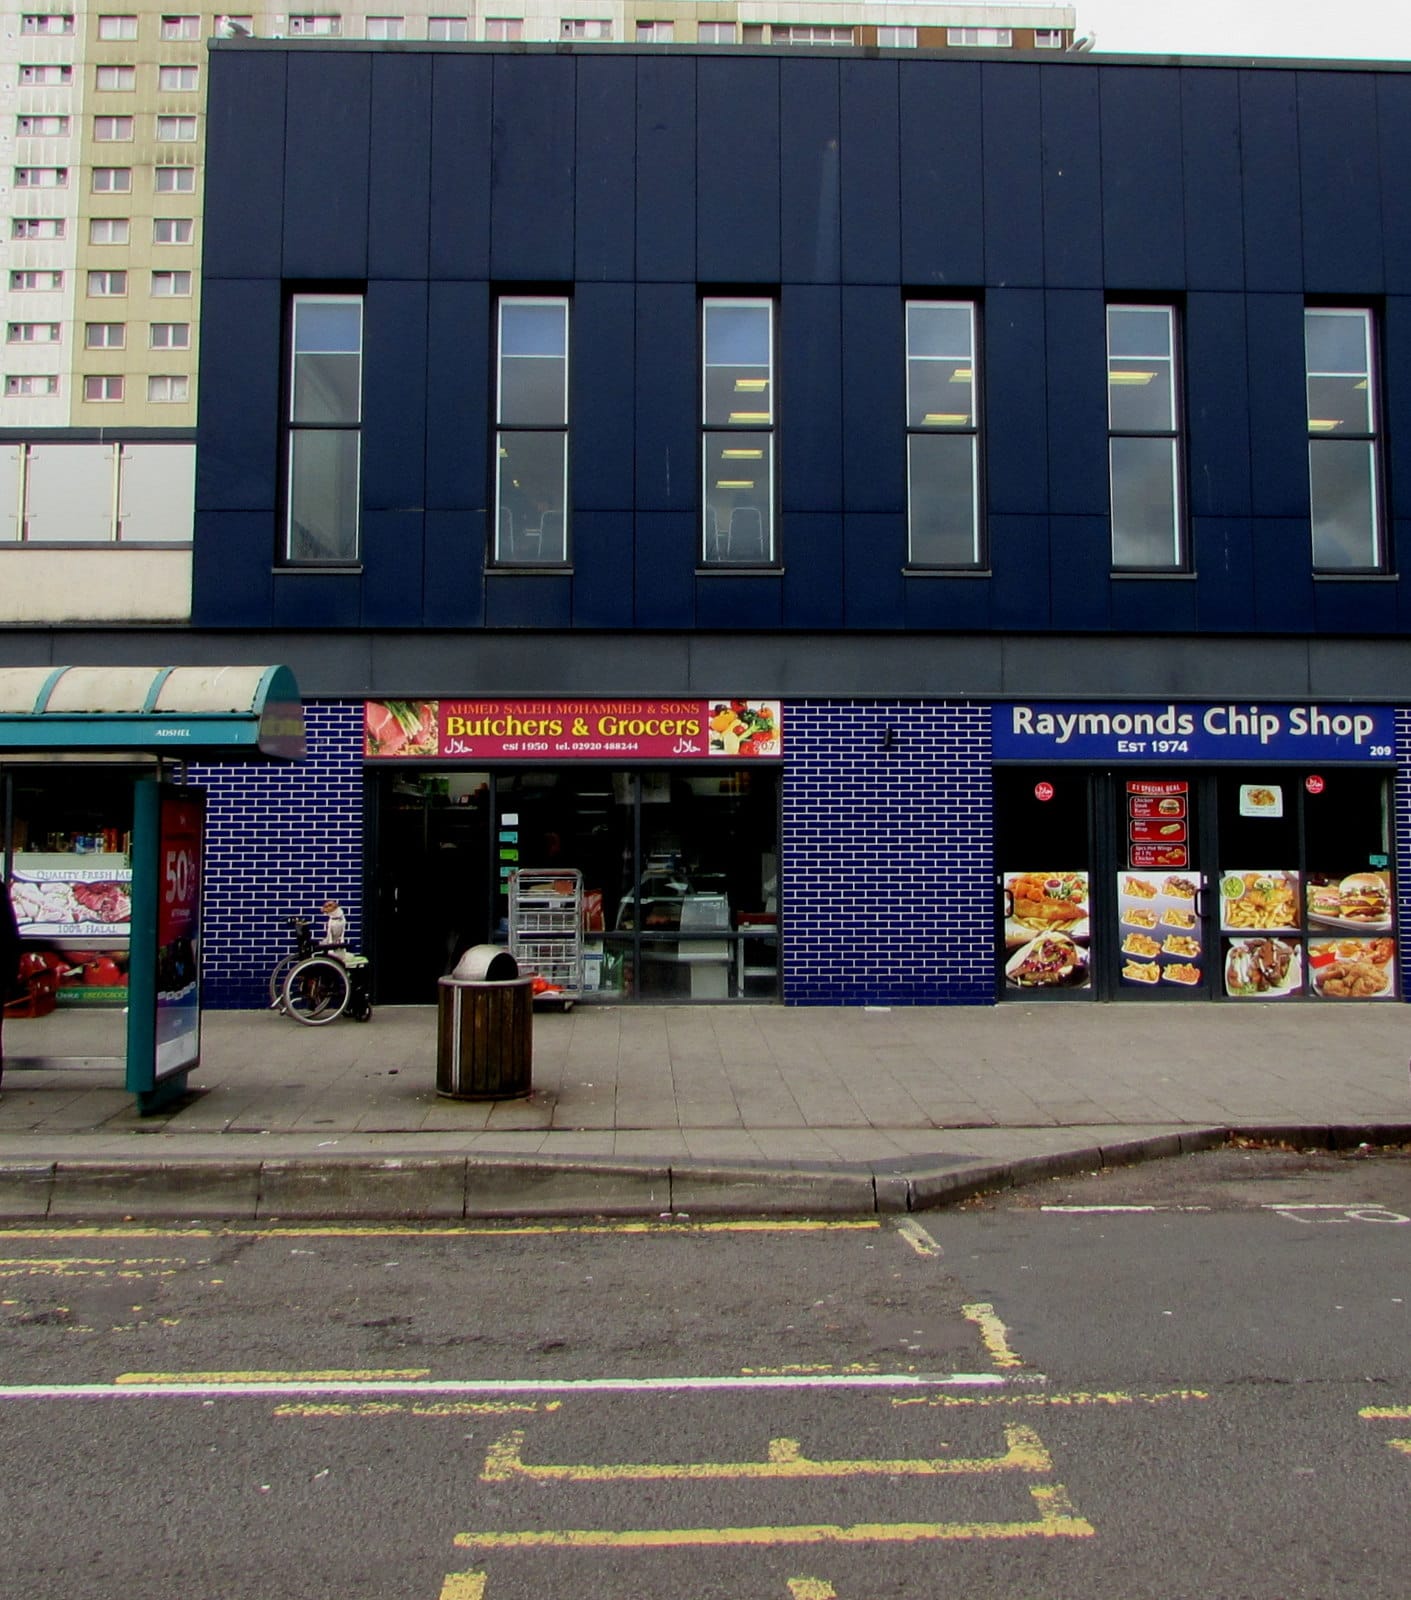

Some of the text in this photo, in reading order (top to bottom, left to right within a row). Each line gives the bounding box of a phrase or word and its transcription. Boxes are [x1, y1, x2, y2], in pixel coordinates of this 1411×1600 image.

[446, 703, 700, 715] AHMED SALEH MOHAMMED & SONS
[446, 716, 700, 737] Butchers & Grocers
[1013, 706, 1374, 745] Raymonds Chip Shop
[155, 728, 191, 737] ADSHEL
[502, 741, 639, 752] est 1950 tel. 02920 488244
[753, 741, 776, 752] 207
[1151, 741, 1188, 753] 1974
[1369, 746, 1392, 757] 209
[37, 871, 79, 880] QUALITY
[82, 871, 112, 880] FRESH
[58, 924, 118, 934] 100% HALAL
